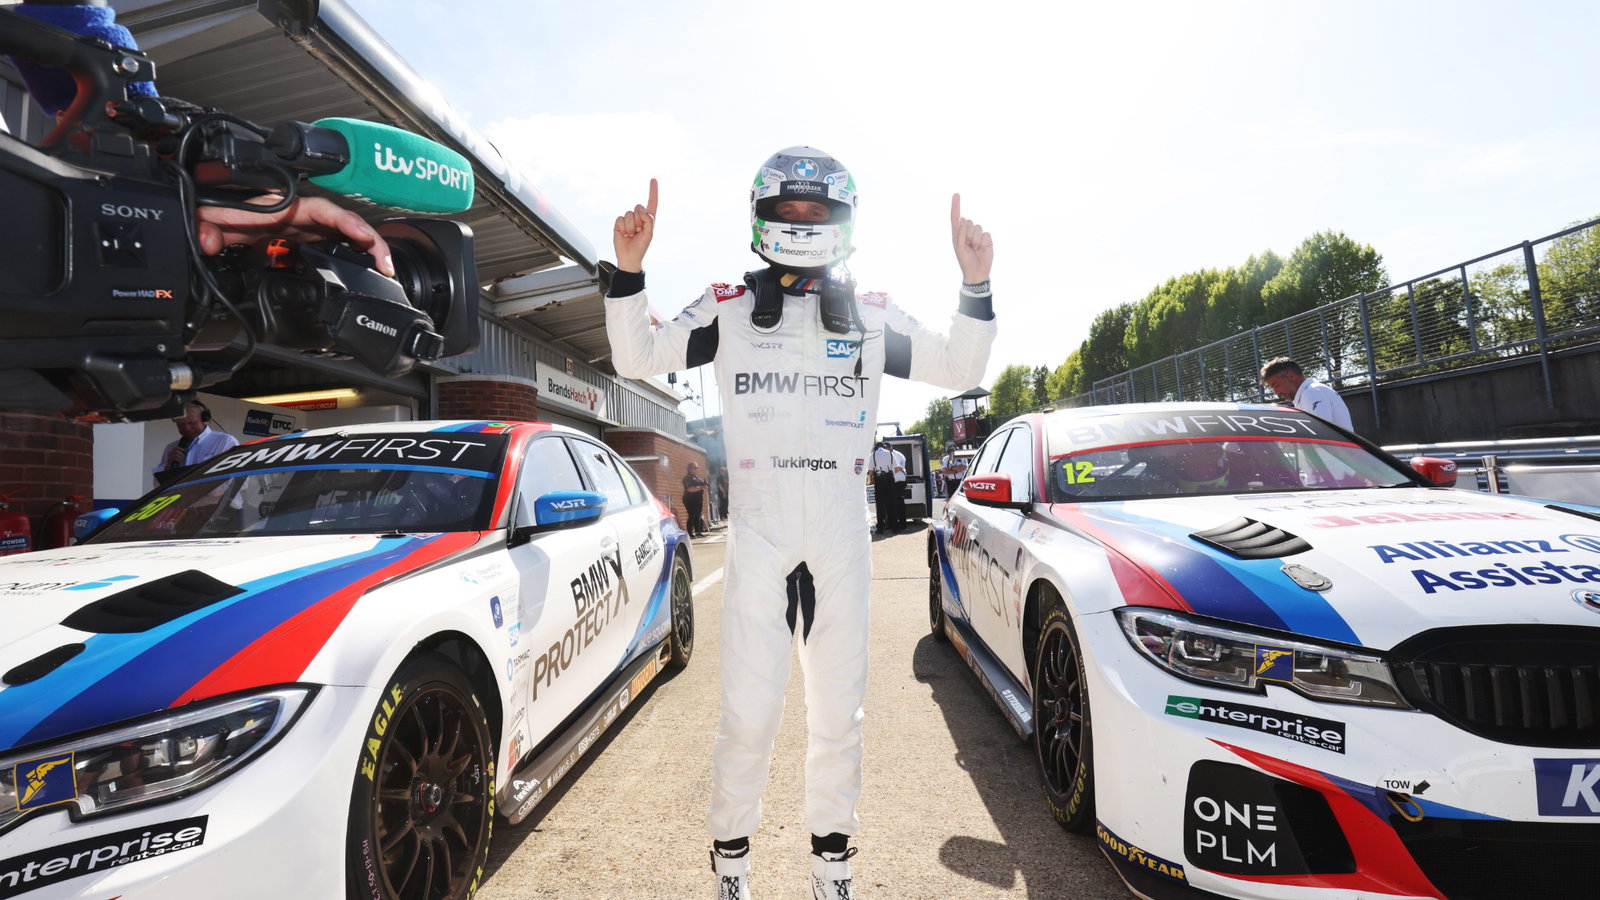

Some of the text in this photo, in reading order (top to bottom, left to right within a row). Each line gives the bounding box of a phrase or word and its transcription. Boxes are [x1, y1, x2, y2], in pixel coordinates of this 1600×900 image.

[374, 143, 470, 191] itv SPORT
[101, 203, 164, 220] SONY
[780, 246, 827, 256] Breezemount
[716, 288, 739, 297] OMP
[356, 314, 397, 337] Canon
[827, 341, 856, 356] SAP
[735, 372, 869, 398] BMW FIRST
[272, 420, 292, 430] BTCC
[770, 456, 837, 471] Turkington
[1062, 461, 1095, 484] 12
[968, 481, 996, 490] WSR
[550, 498, 586, 509] WSR
[1367, 540, 1571, 564] Allianz
[570, 555, 610, 619] BMW
[532, 590, 612, 702] PROTECT
[360, 683, 403, 783] EAGLE
[1175, 702, 1343, 745] enterprise
[1277, 730, 1342, 752] rent-a-car
[1384, 779, 1411, 790] TOW
[1193, 796, 1277, 832] ONE
[110, 839, 200, 867] rent-a-car
[1196, 829, 1277, 868] PLM
